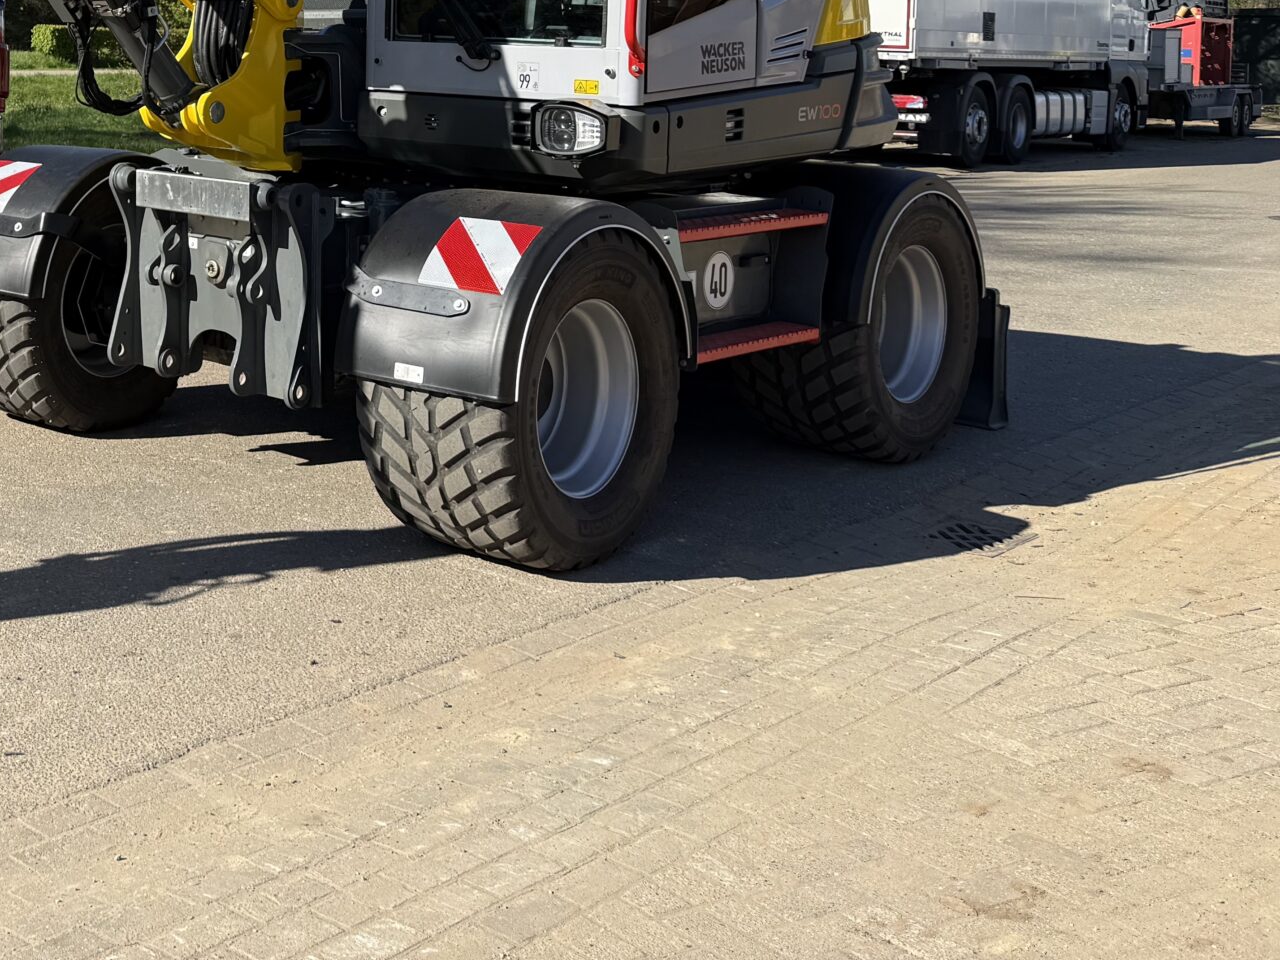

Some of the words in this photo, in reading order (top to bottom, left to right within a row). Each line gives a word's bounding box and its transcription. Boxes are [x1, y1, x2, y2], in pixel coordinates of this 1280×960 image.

[700, 41, 745, 60] WACKER
[701, 56, 746, 75] NEUSON
[519, 73, 531, 89] 99
[798, 103, 841, 122] EW100
[709, 261, 728, 299] 40
